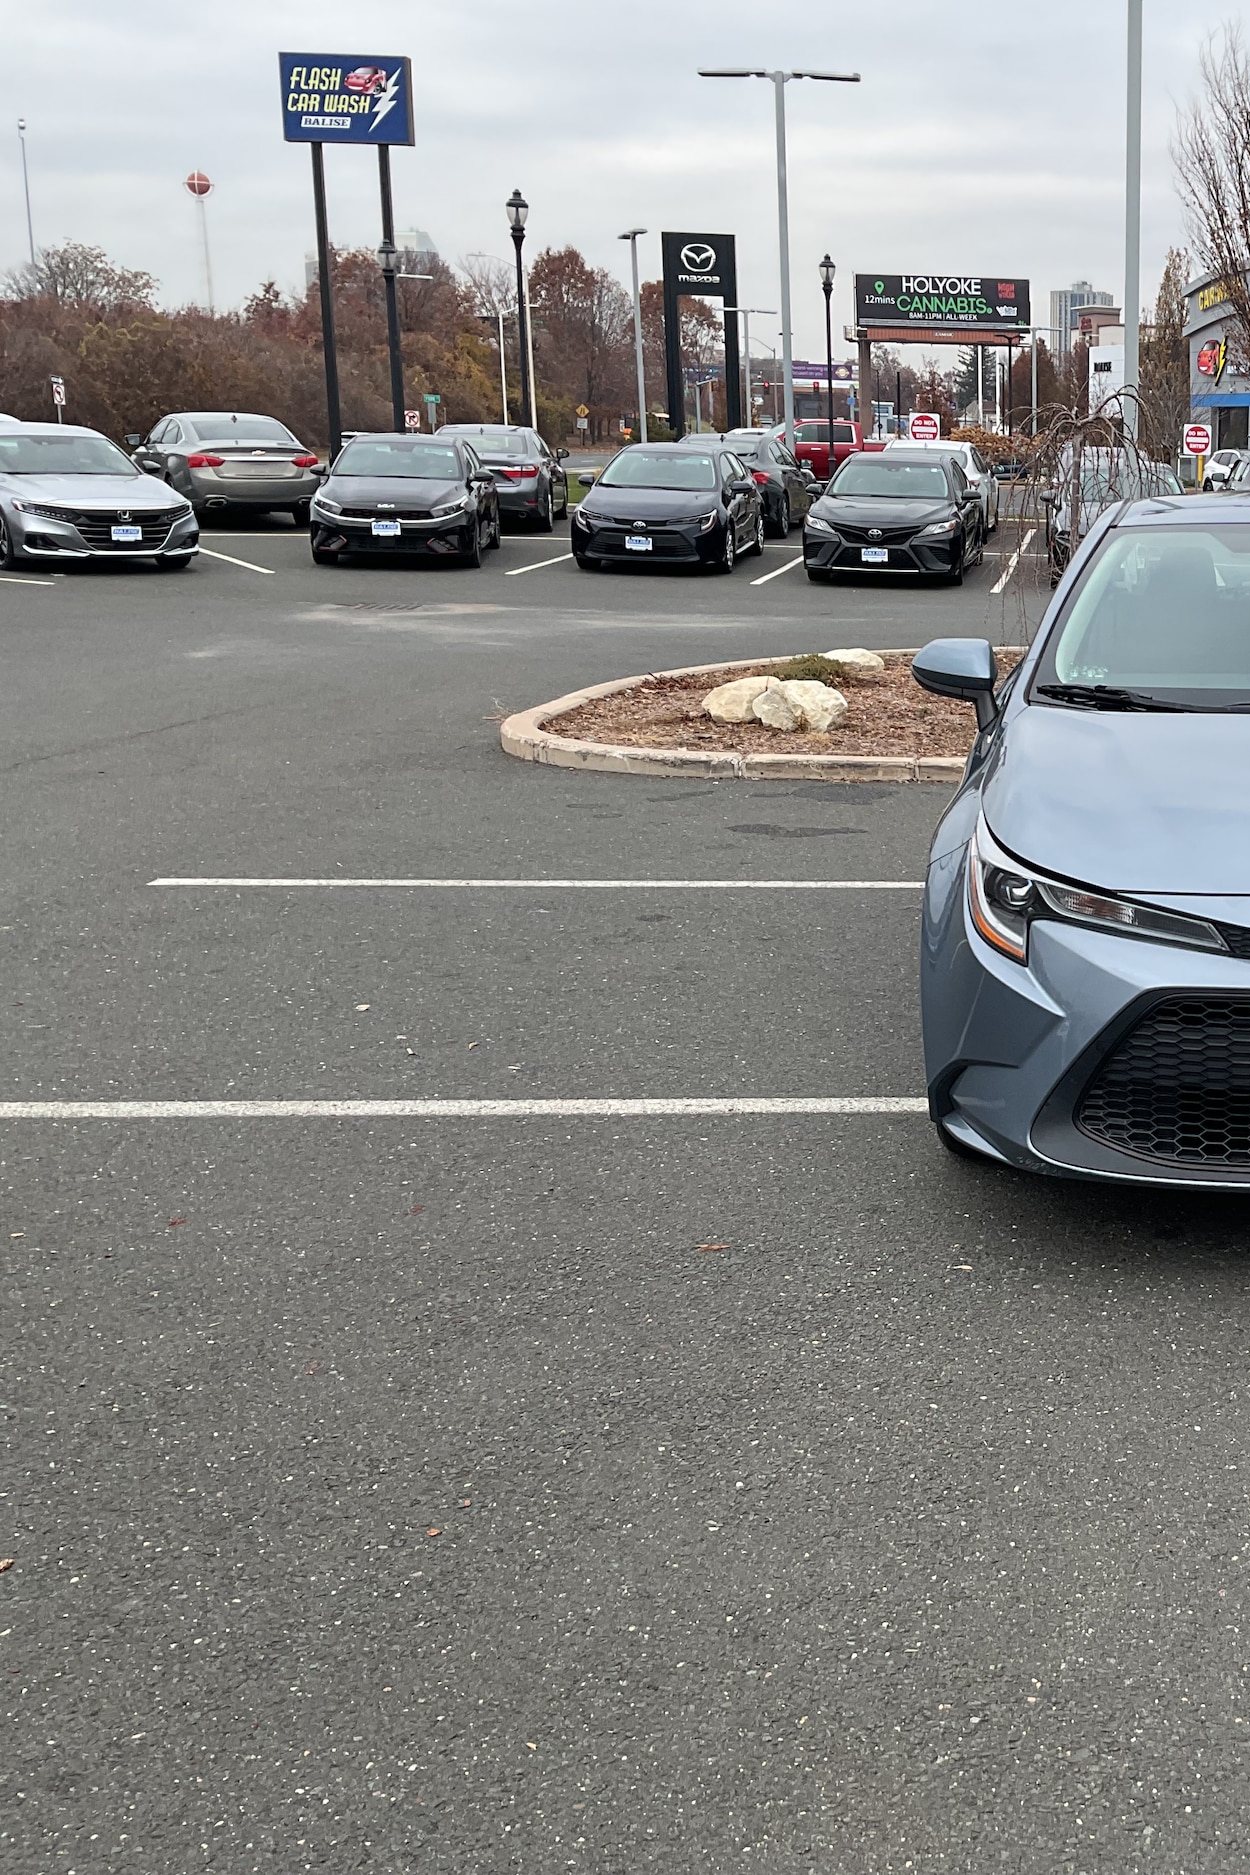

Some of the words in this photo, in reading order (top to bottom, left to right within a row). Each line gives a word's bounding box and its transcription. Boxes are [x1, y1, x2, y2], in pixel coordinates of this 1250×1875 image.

[290, 67, 341, 90] FLASH
[287, 93, 320, 112] CAR
[324, 94, 370, 113] WASH
[303, 117, 349, 127] BALISE
[902, 277, 981, 296] HOLYOKE
[865, 295, 895, 305] 12mins
[909, 312, 942, 320] 8AM-11PM
